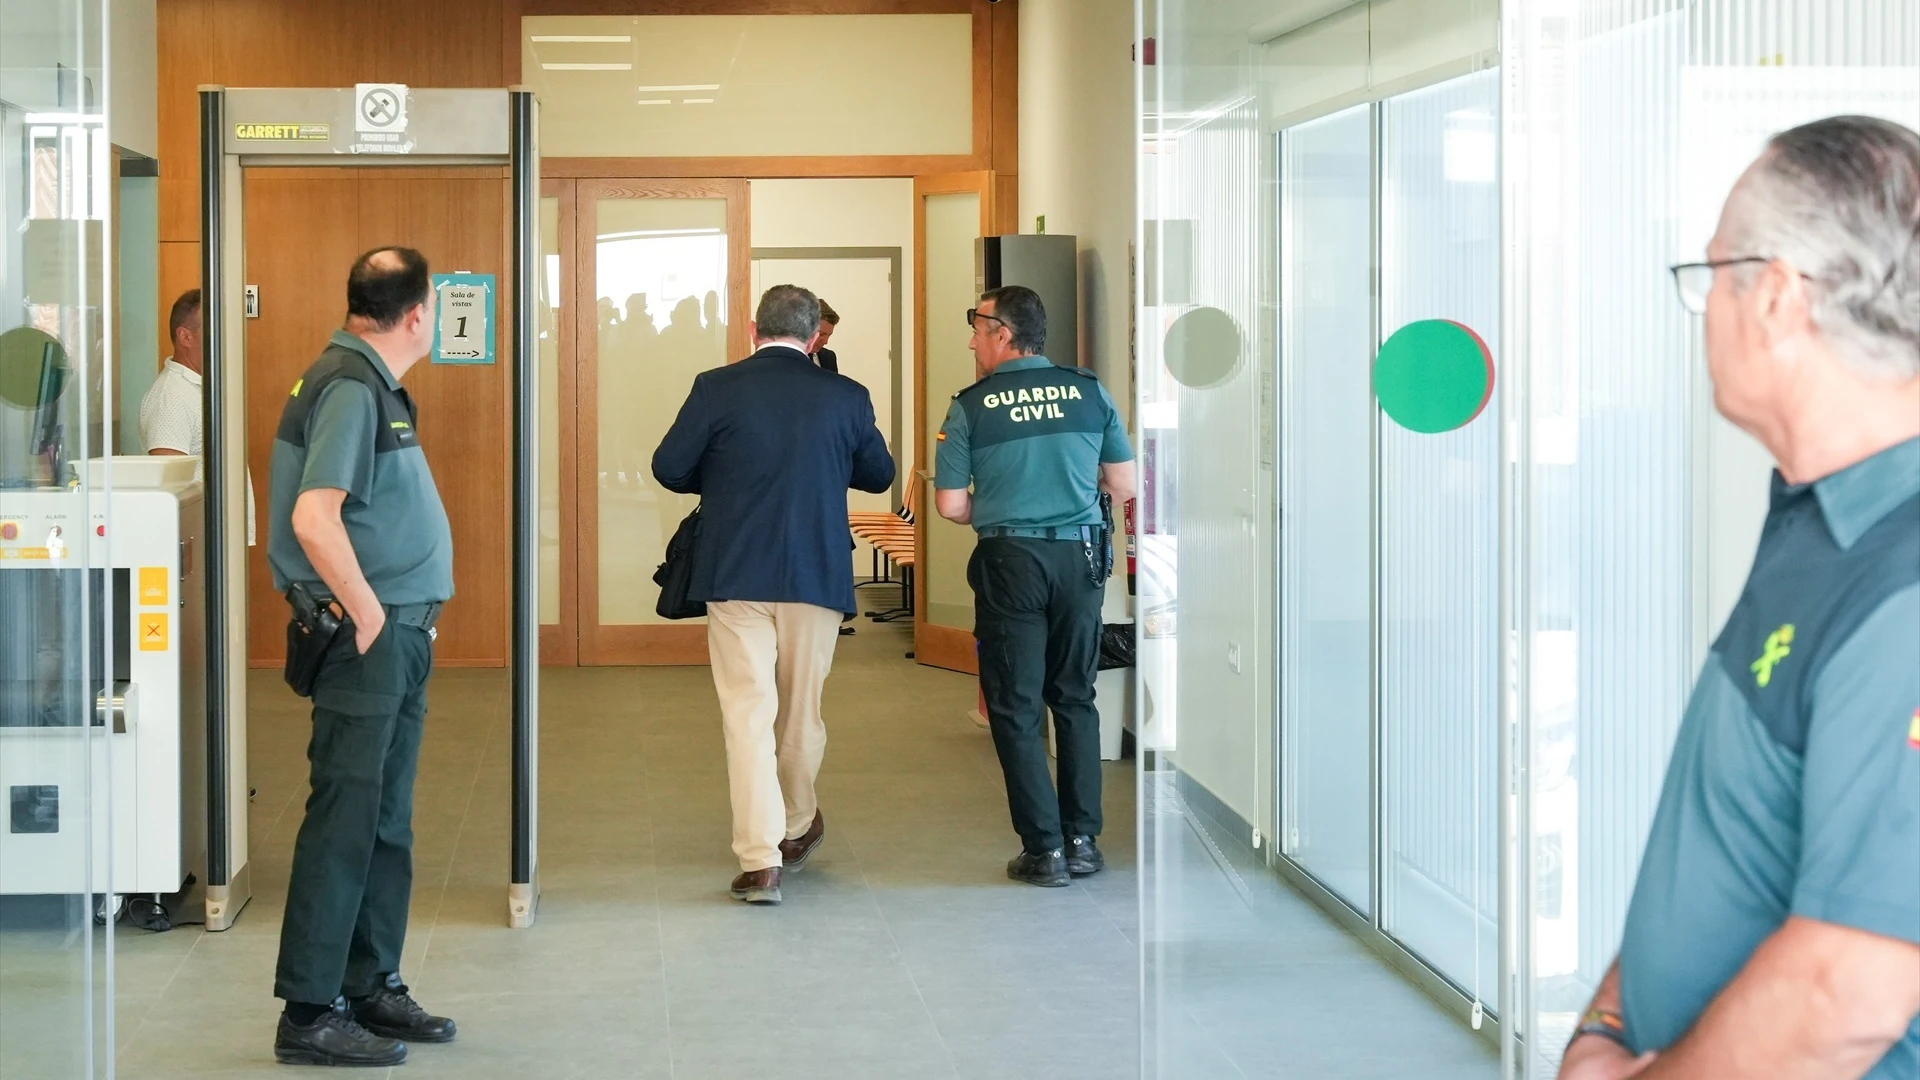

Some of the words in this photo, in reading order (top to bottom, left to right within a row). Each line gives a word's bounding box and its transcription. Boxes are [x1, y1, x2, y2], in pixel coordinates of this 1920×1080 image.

[236, 125, 299, 139] GARRETT
[454, 316, 468, 338] 1
[983, 385, 1083, 409] GUARDIA
[1009, 403, 1065, 423] CIVIL
